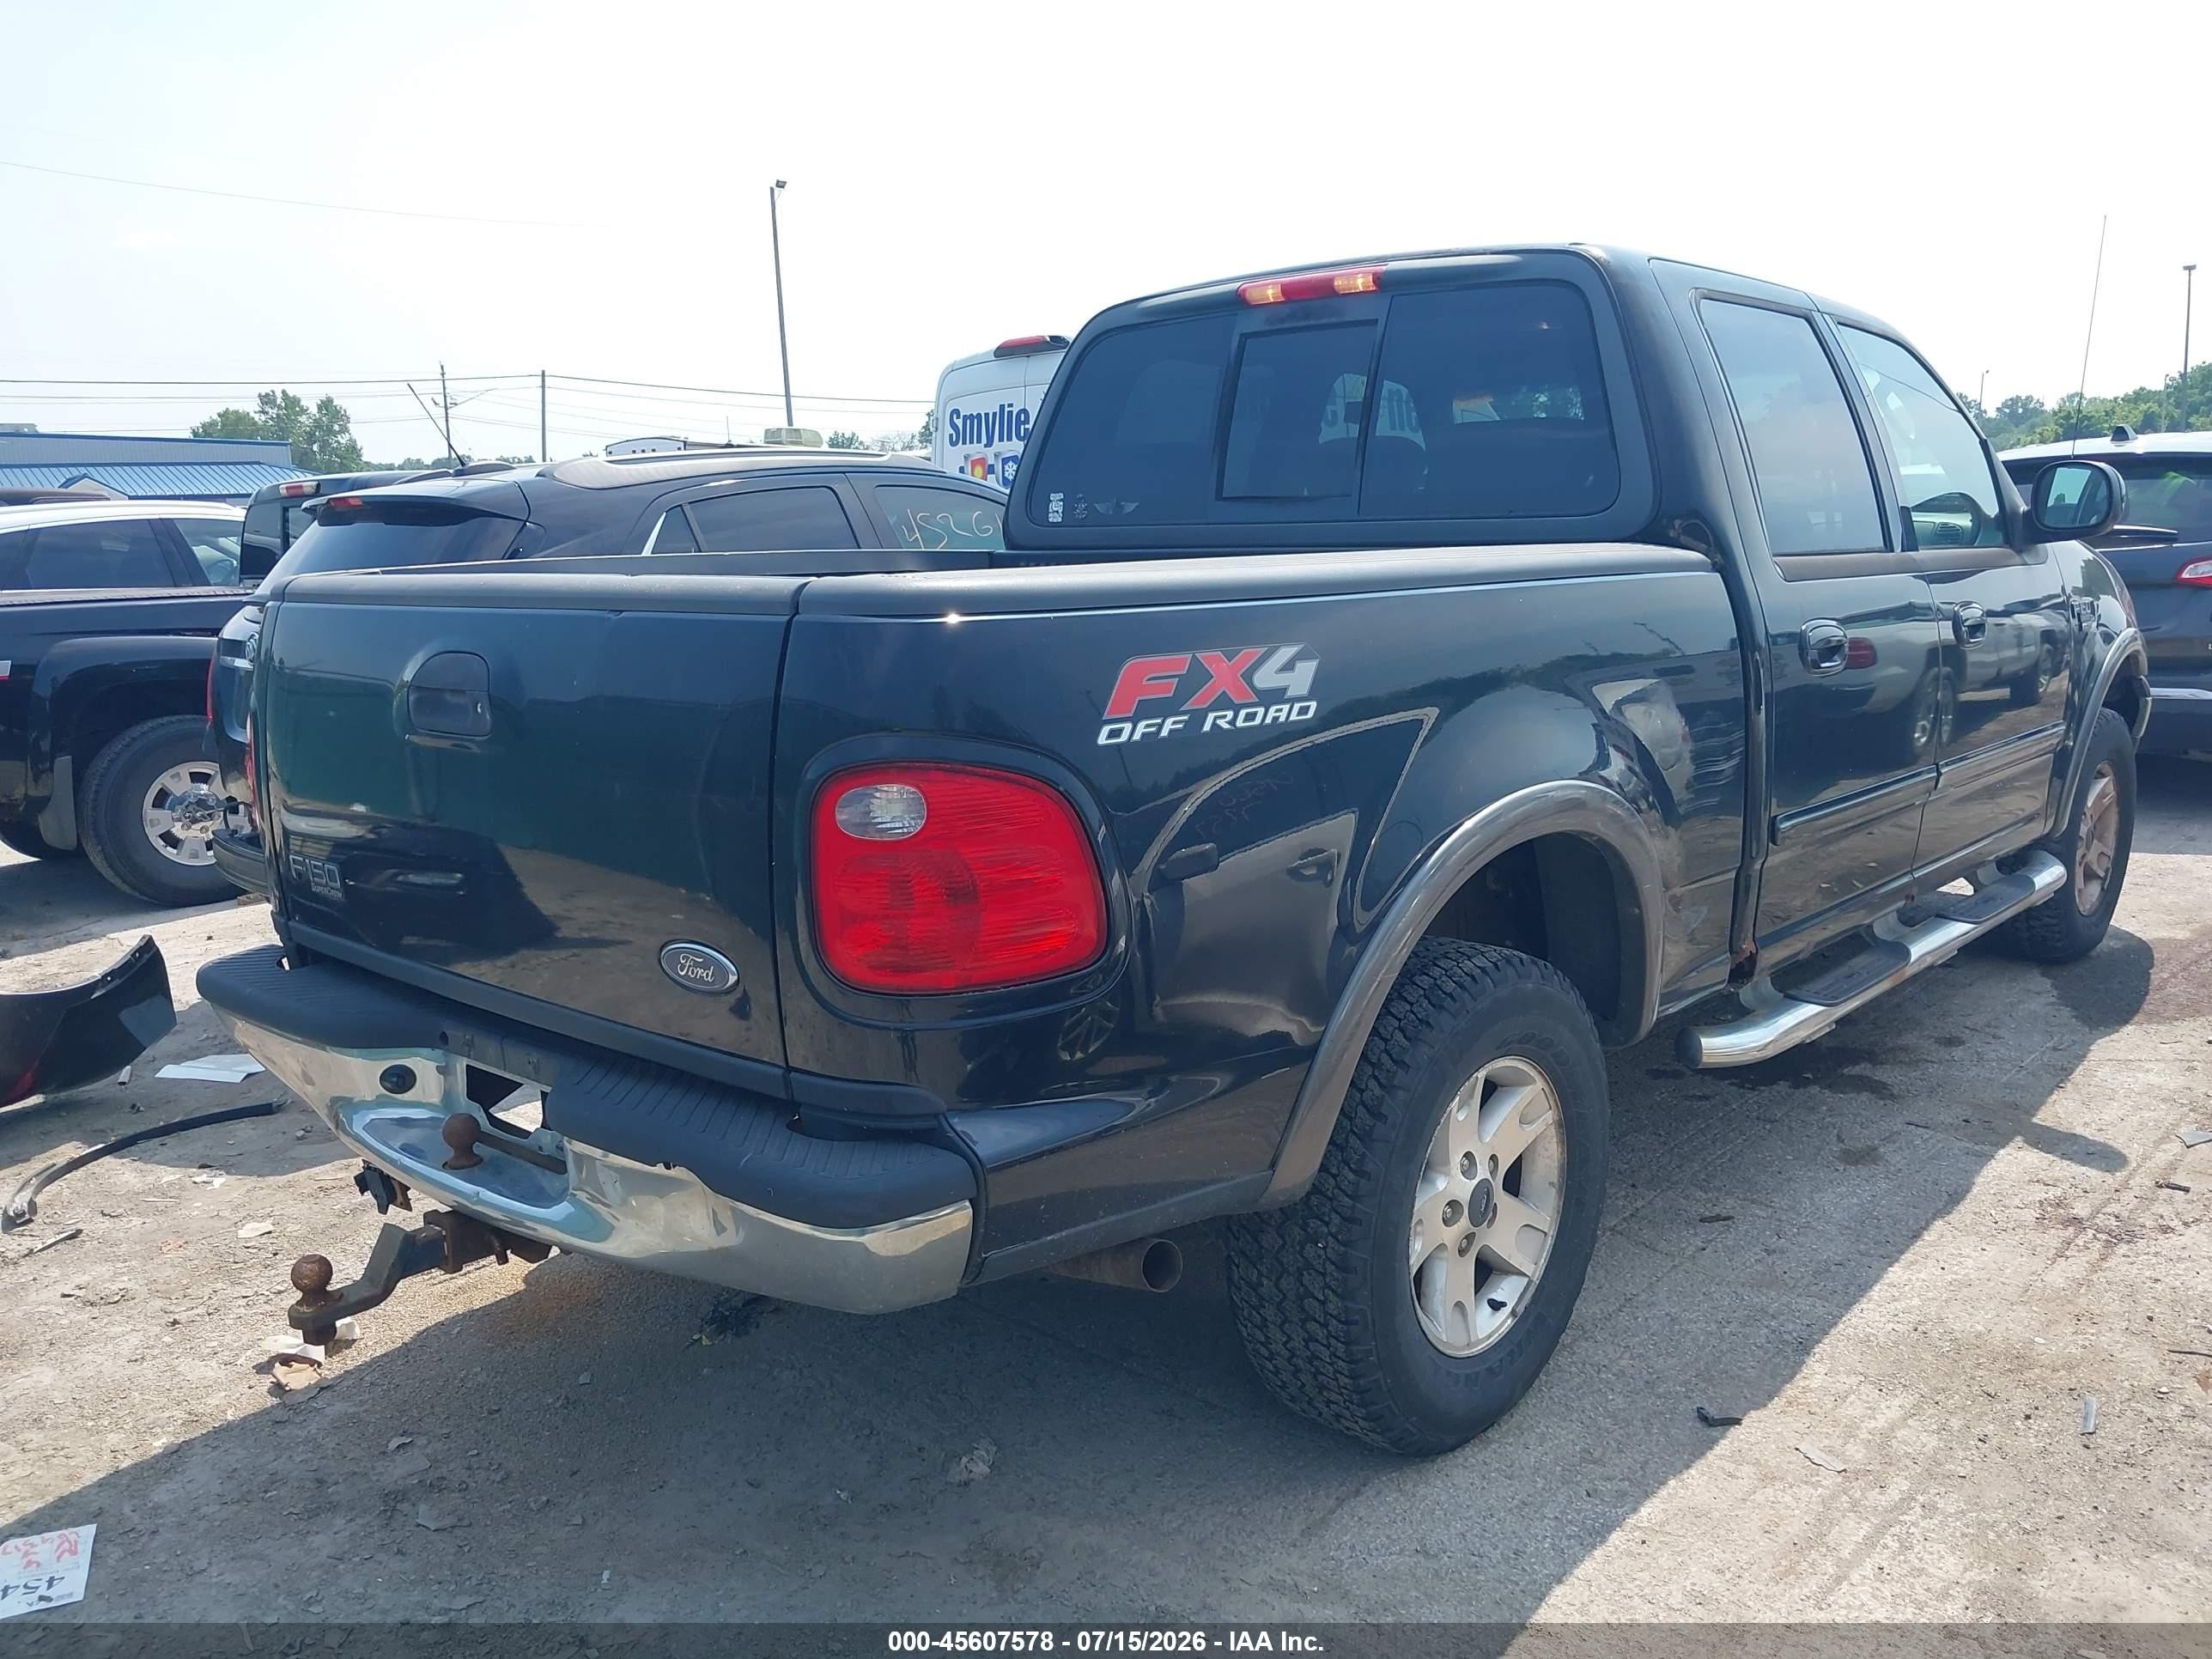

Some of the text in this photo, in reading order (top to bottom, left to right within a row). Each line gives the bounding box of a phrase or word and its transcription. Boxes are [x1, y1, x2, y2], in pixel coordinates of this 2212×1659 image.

[949, 403, 1030, 448] Smylie
[1103, 644, 1320, 720] FX4
[1097, 701, 1318, 746] OFF ROAD
[678, 953, 714, 982] Ford
